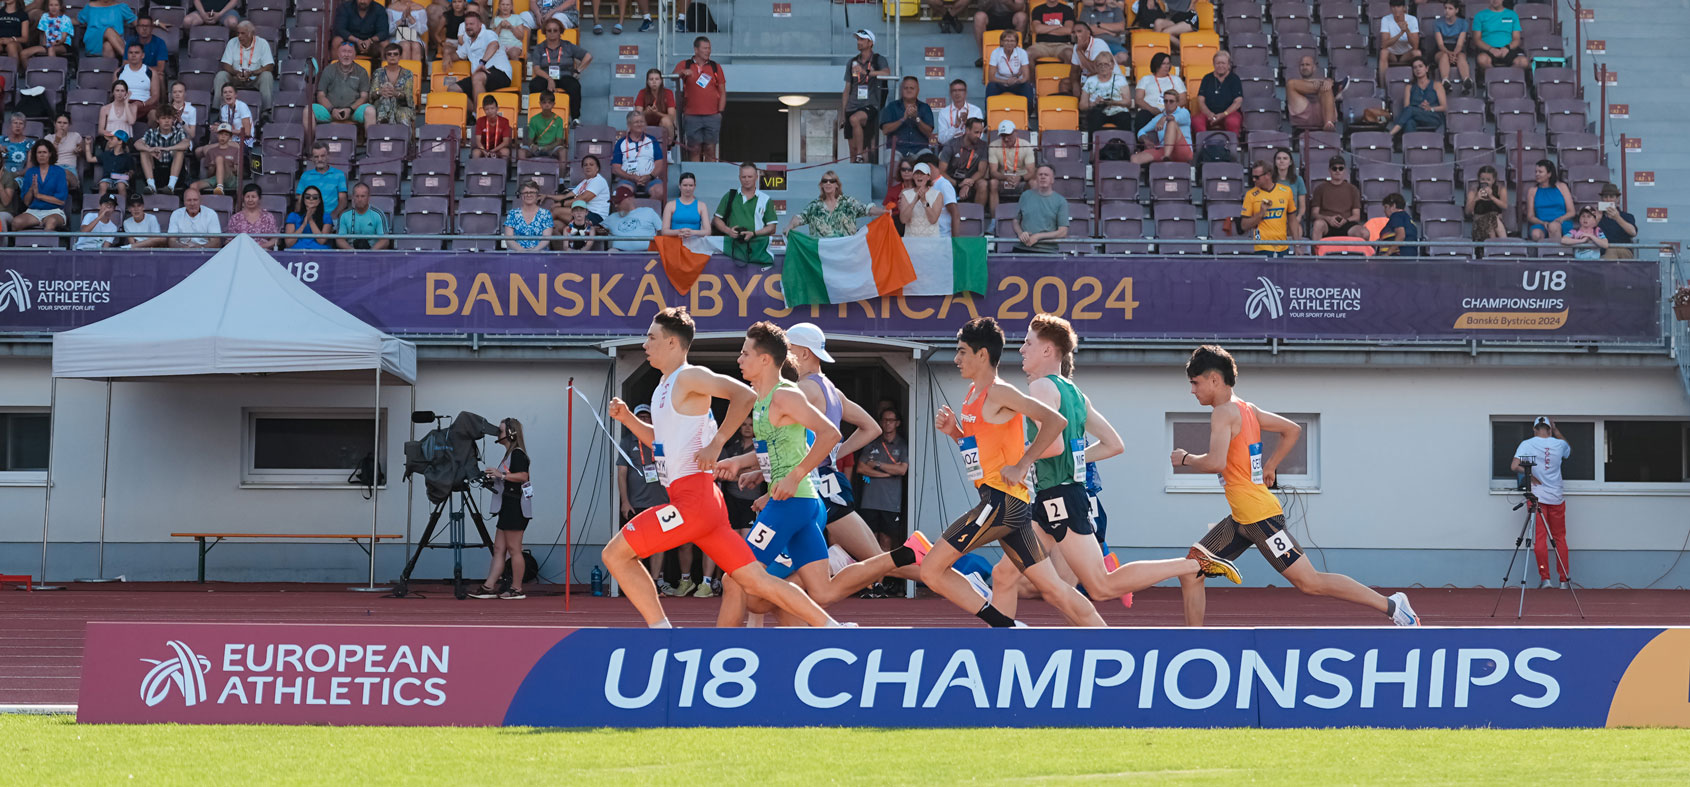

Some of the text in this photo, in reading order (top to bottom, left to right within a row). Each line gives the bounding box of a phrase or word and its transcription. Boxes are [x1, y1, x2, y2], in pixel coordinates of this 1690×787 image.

[763, 177, 784, 188] VIP
[37, 280, 111, 292] EUROPEAN
[1522, 270, 1567, 291] U18
[425, 259, 667, 317] BANSKÁ
[997, 276, 1140, 320] 2024
[1289, 287, 1361, 299] EUROPEAN
[37, 292, 110, 303] ATHLETICS
[1289, 299, 1361, 311] ATHLETICS
[1462, 298, 1564, 309] CHAMPIONSHIPS
[1466, 316, 1561, 327] Banská Bystrica 2024
[822, 478, 831, 495] 7
[661, 510, 676, 523] 3
[1050, 502, 1061, 518] 2
[754, 529, 768, 544] 5
[1273, 537, 1286, 552] 8
[222, 643, 450, 673] EUROPEAN
[603, 647, 1562, 710] U18 CHAMPIONSHIPS
[216, 676, 447, 706] ATHLETICS
